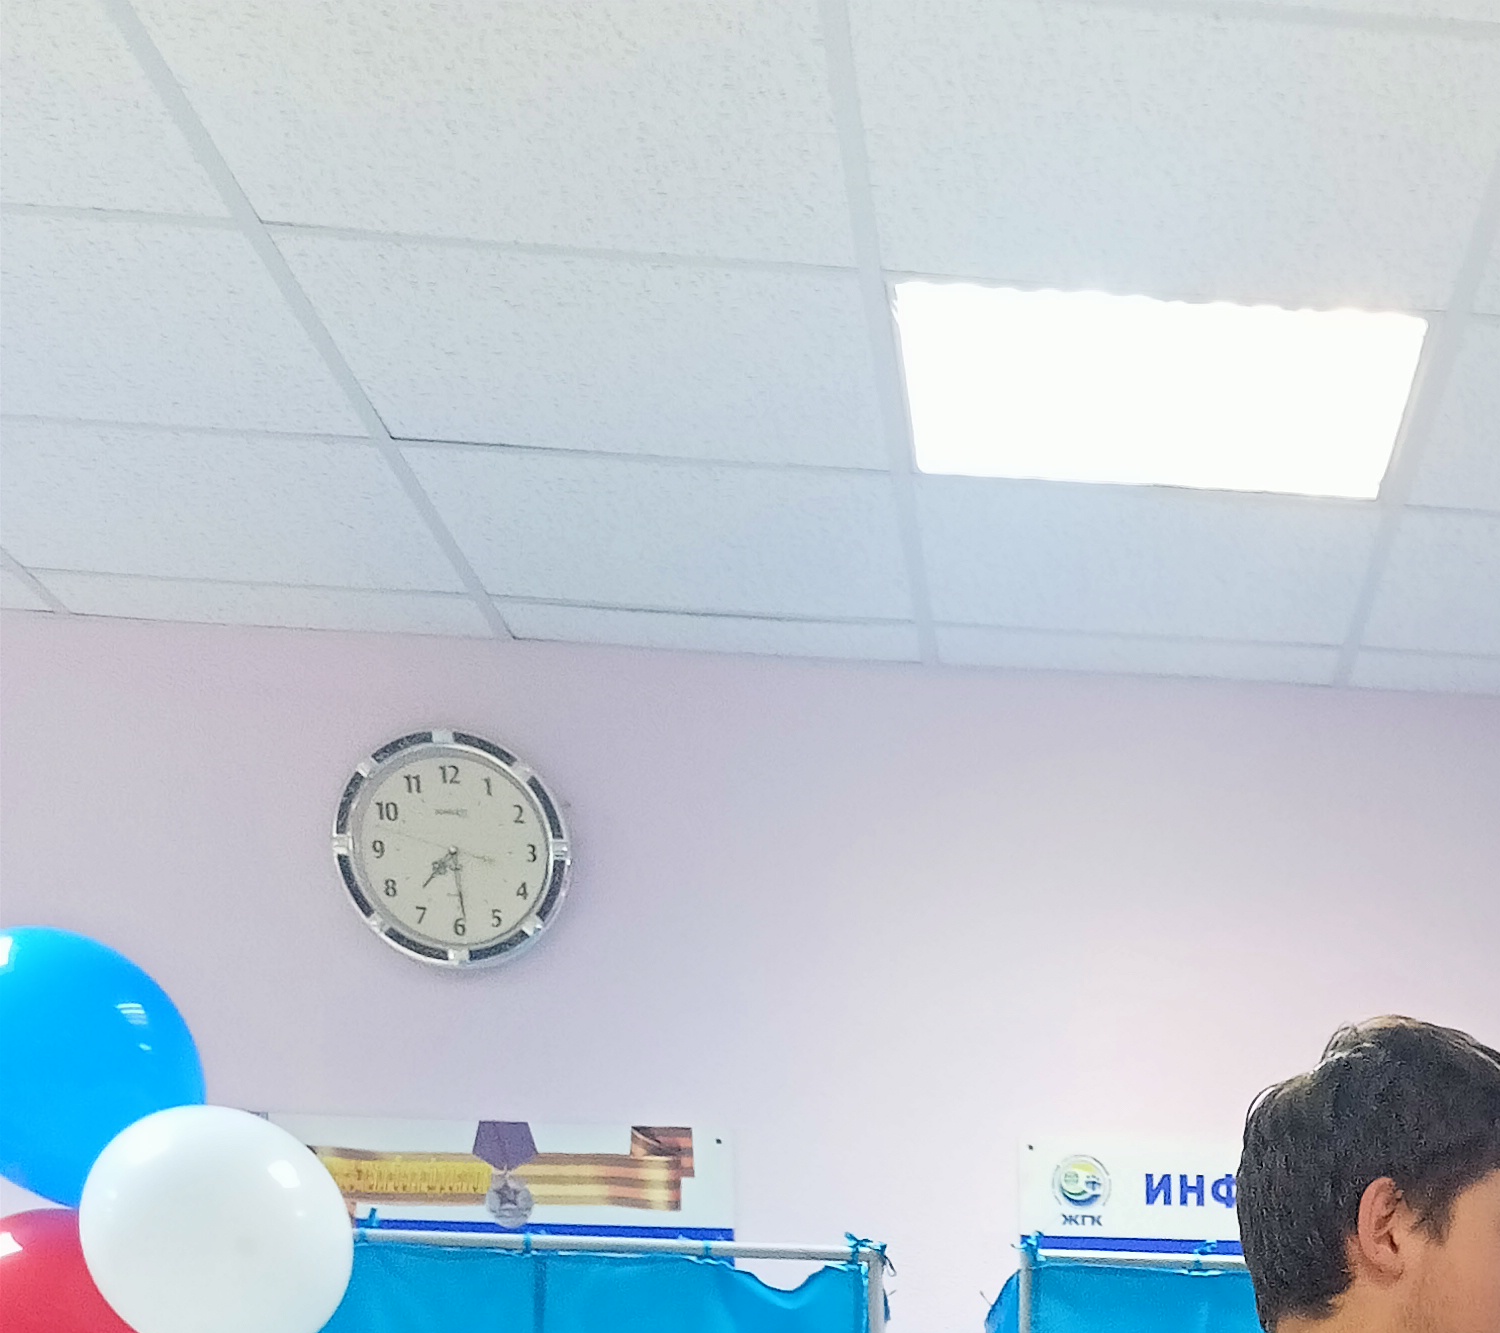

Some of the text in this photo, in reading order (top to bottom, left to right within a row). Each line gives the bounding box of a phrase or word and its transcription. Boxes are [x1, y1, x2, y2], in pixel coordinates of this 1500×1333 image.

[403, 774, 422, 794] 11
[439, 765, 461, 784] 12
[483, 777, 493, 796] 1
[376, 801, 398, 821] 10
[514, 805, 525, 824] 2
[372, 840, 385, 858] 9
[527, 844, 537, 863] 3
[385, 878, 397, 897] 8
[516, 882, 528, 900] 4
[415, 906, 427, 924] 7
[491, 909, 502, 928] 5
[454, 917, 466, 936] 6
[1062, 1214, 1103, 1226] ЖГК
